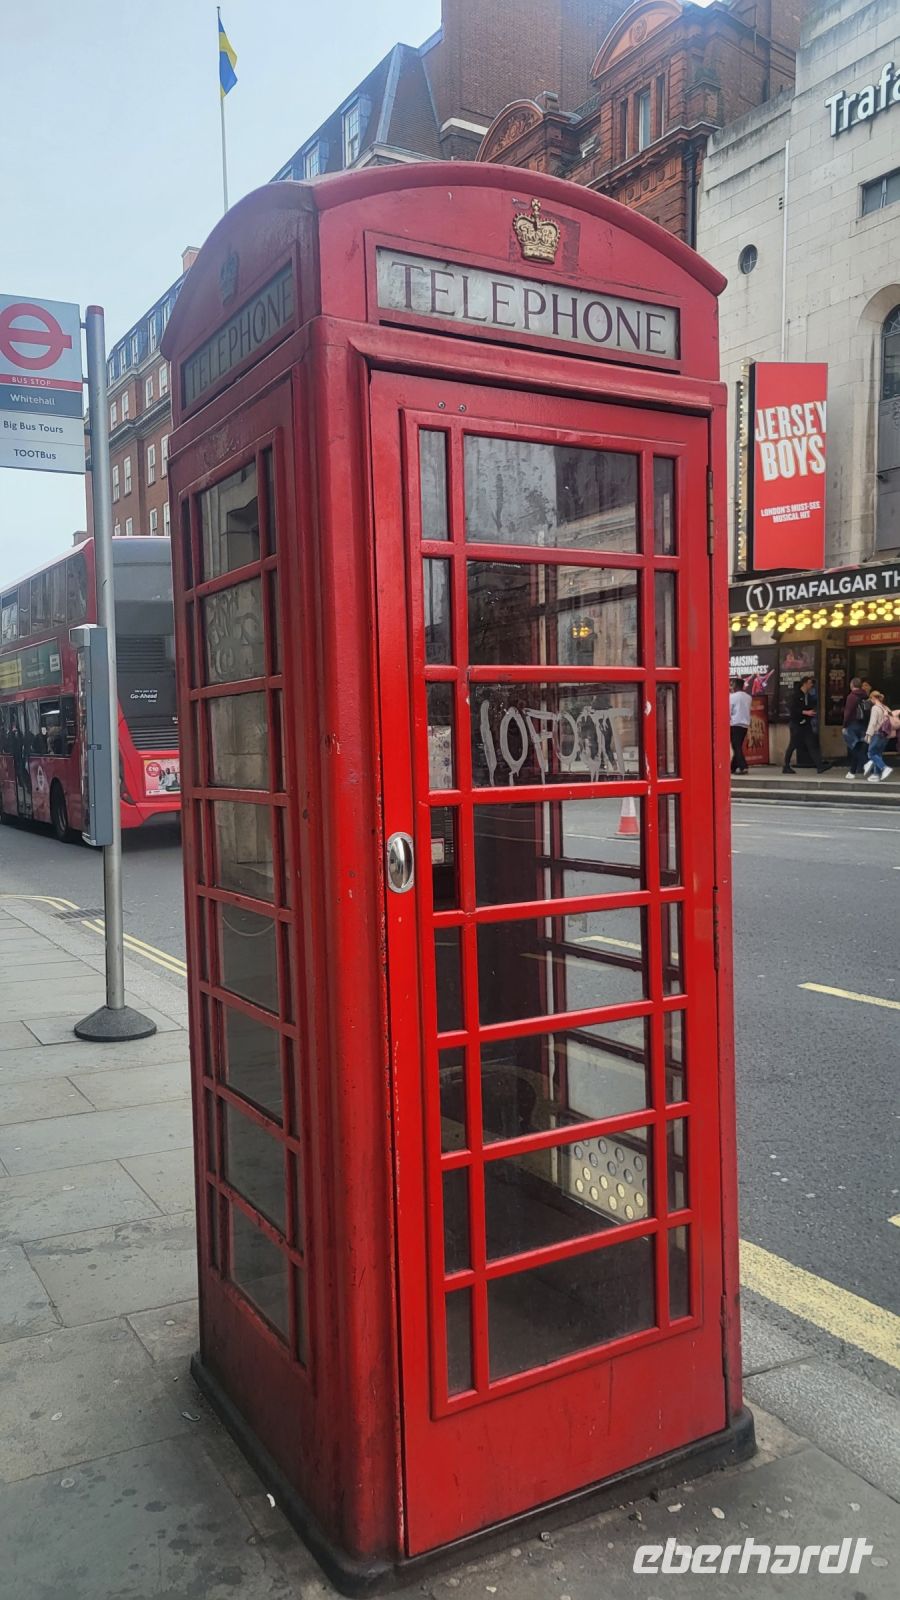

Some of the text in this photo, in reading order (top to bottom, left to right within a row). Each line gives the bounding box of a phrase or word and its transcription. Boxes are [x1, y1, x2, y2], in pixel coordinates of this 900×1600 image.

[391, 261, 668, 355] TELEPHONE
[190, 273, 294, 399] TELEPHONE
[11, 376, 52, 387] BUS STOP
[10, 393, 56, 406] Whitehall
[3, 420, 64, 434] Big Bus Tours
[755, 400, 827, 442] JERSEY
[13, 448, 57, 460] TOOTBus
[759, 435, 826, 482] BOYS
[772, 512, 799, 523] MUSICAL
[776, 573, 877, 602] TRAFALGAR
